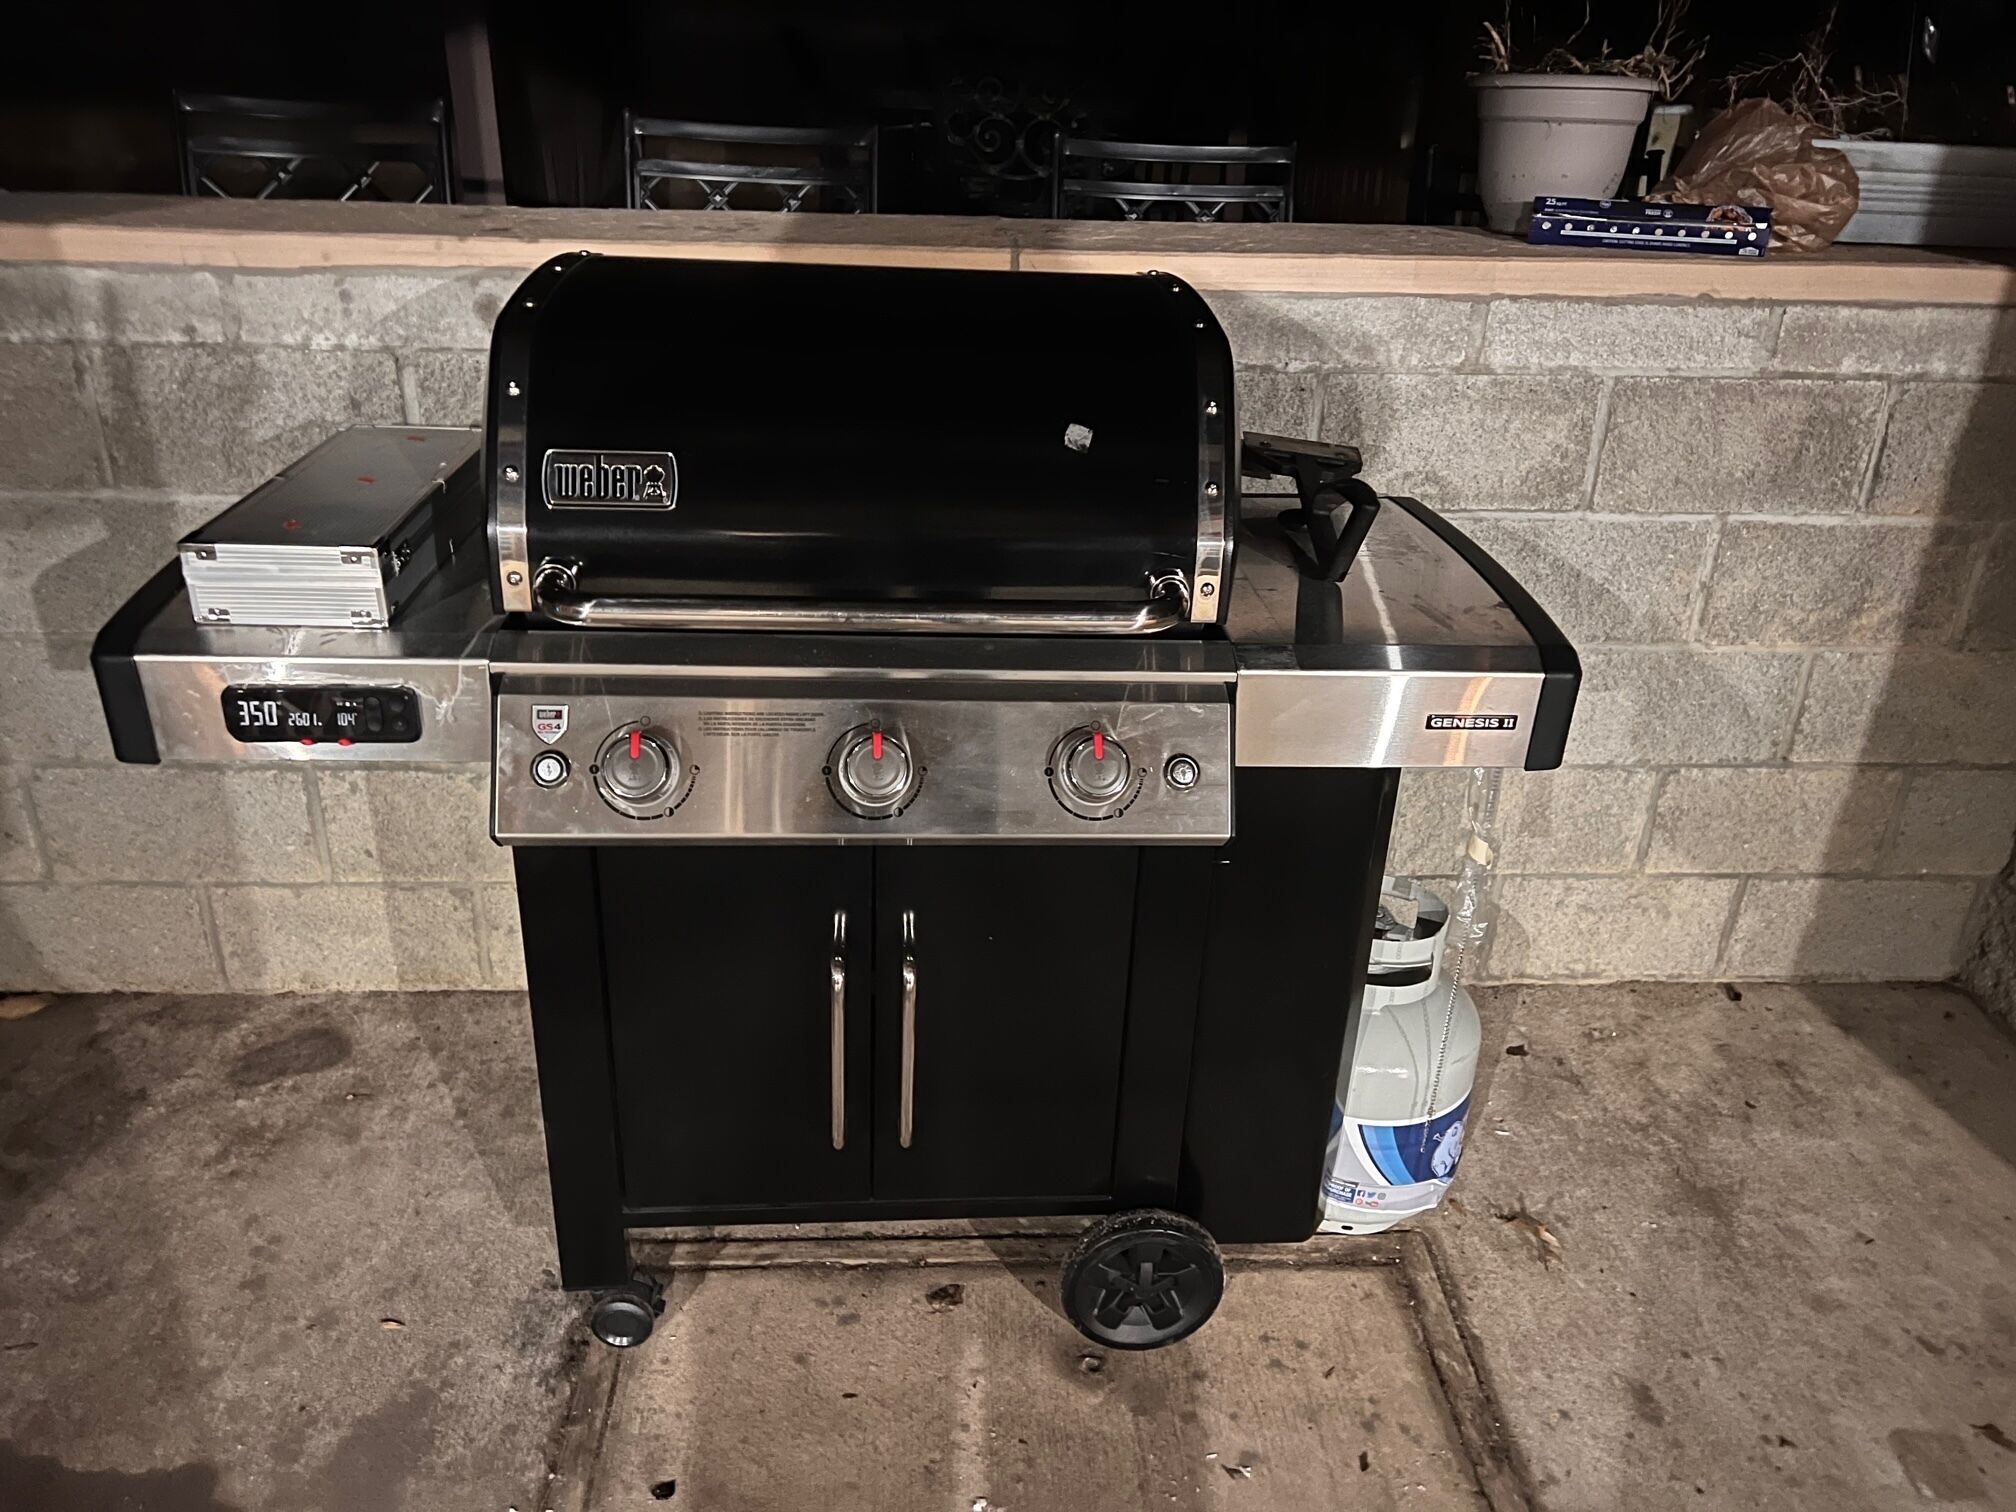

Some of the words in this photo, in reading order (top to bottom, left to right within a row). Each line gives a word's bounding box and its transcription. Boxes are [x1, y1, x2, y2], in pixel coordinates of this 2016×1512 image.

[1545, 197, 1556, 206] 25
[554, 455, 643, 500] weber
[1430, 717, 1500, 728] GENESIS
[1502, 718, 1515, 728] II
